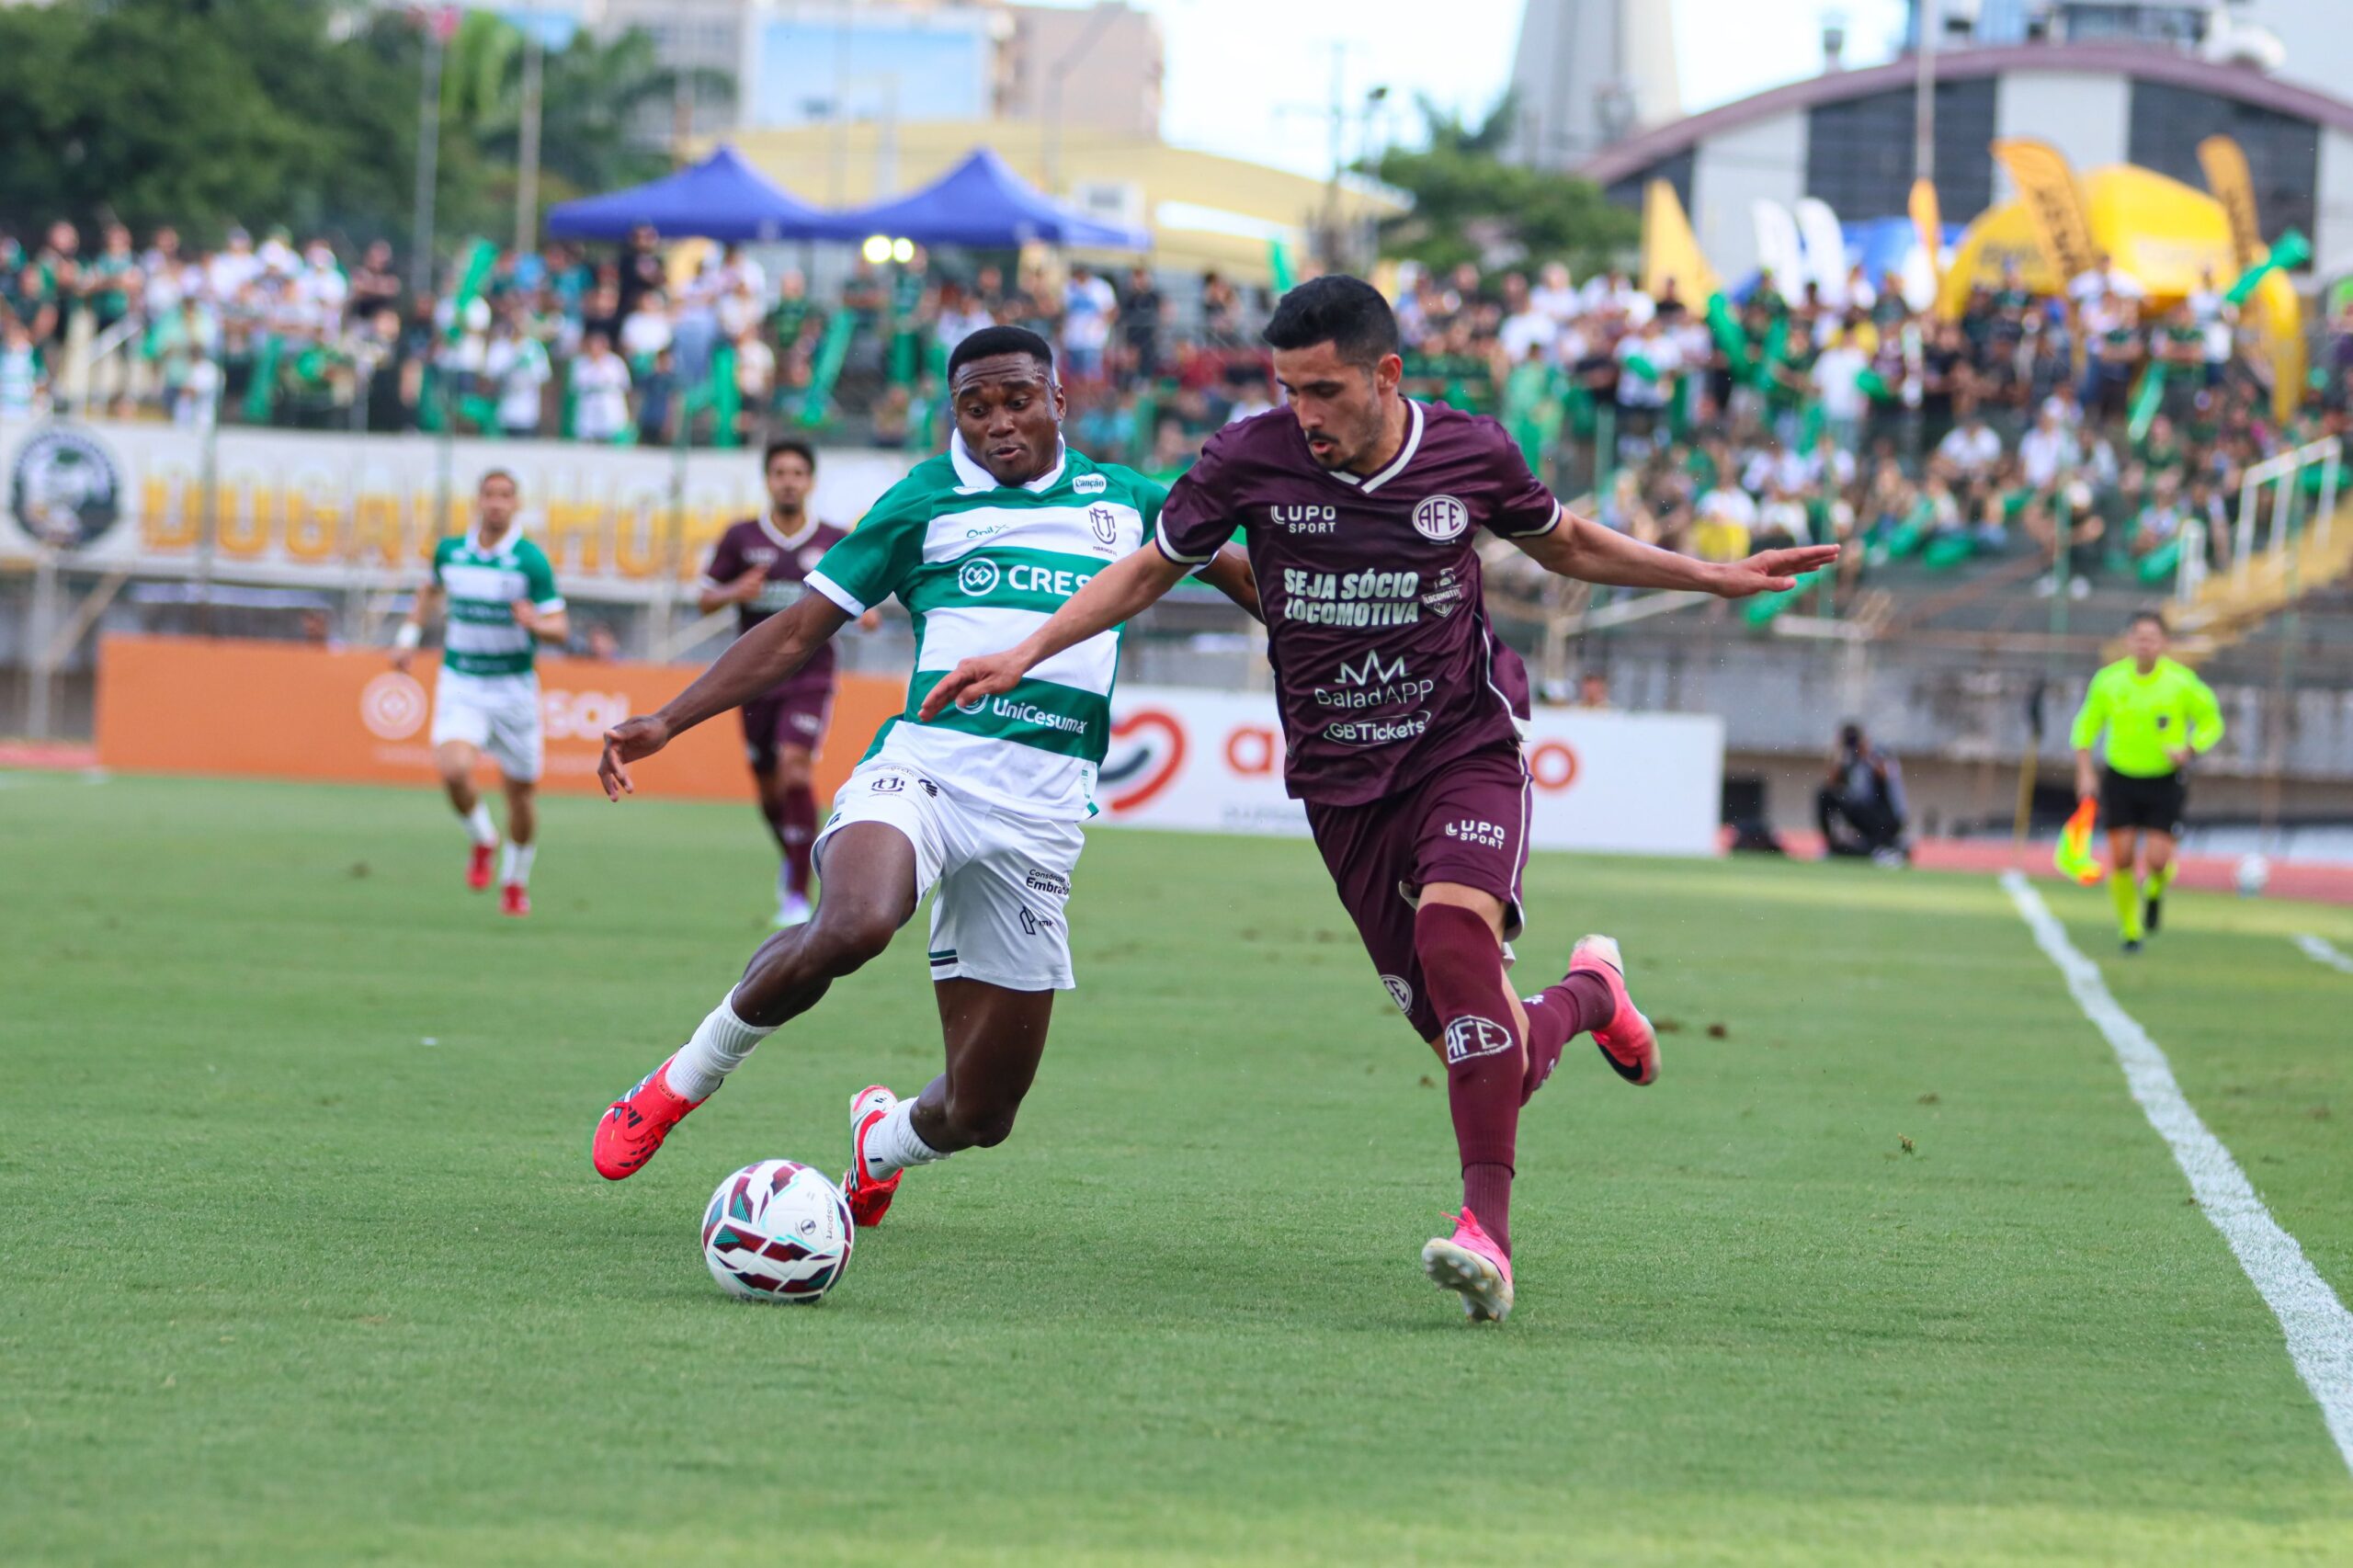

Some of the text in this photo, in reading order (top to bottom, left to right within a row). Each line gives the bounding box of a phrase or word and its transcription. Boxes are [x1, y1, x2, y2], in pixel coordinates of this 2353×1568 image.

[1074, 478, 1105, 490] Canção
[1270, 506, 1336, 525] LUPO
[1417, 500, 1461, 534] AFE
[1289, 522, 1336, 533] SPORT
[1284, 568, 1419, 600] SEJA SÓCIO
[1284, 597, 1419, 627] LOCOMOTIVA
[1314, 679, 1434, 709] BaladAPP
[1329, 719, 1426, 741] GBTickets
[1445, 820, 1505, 840] LUPO
[1460, 832, 1504, 850] SPORT
[1448, 1020, 1499, 1058] AFE
